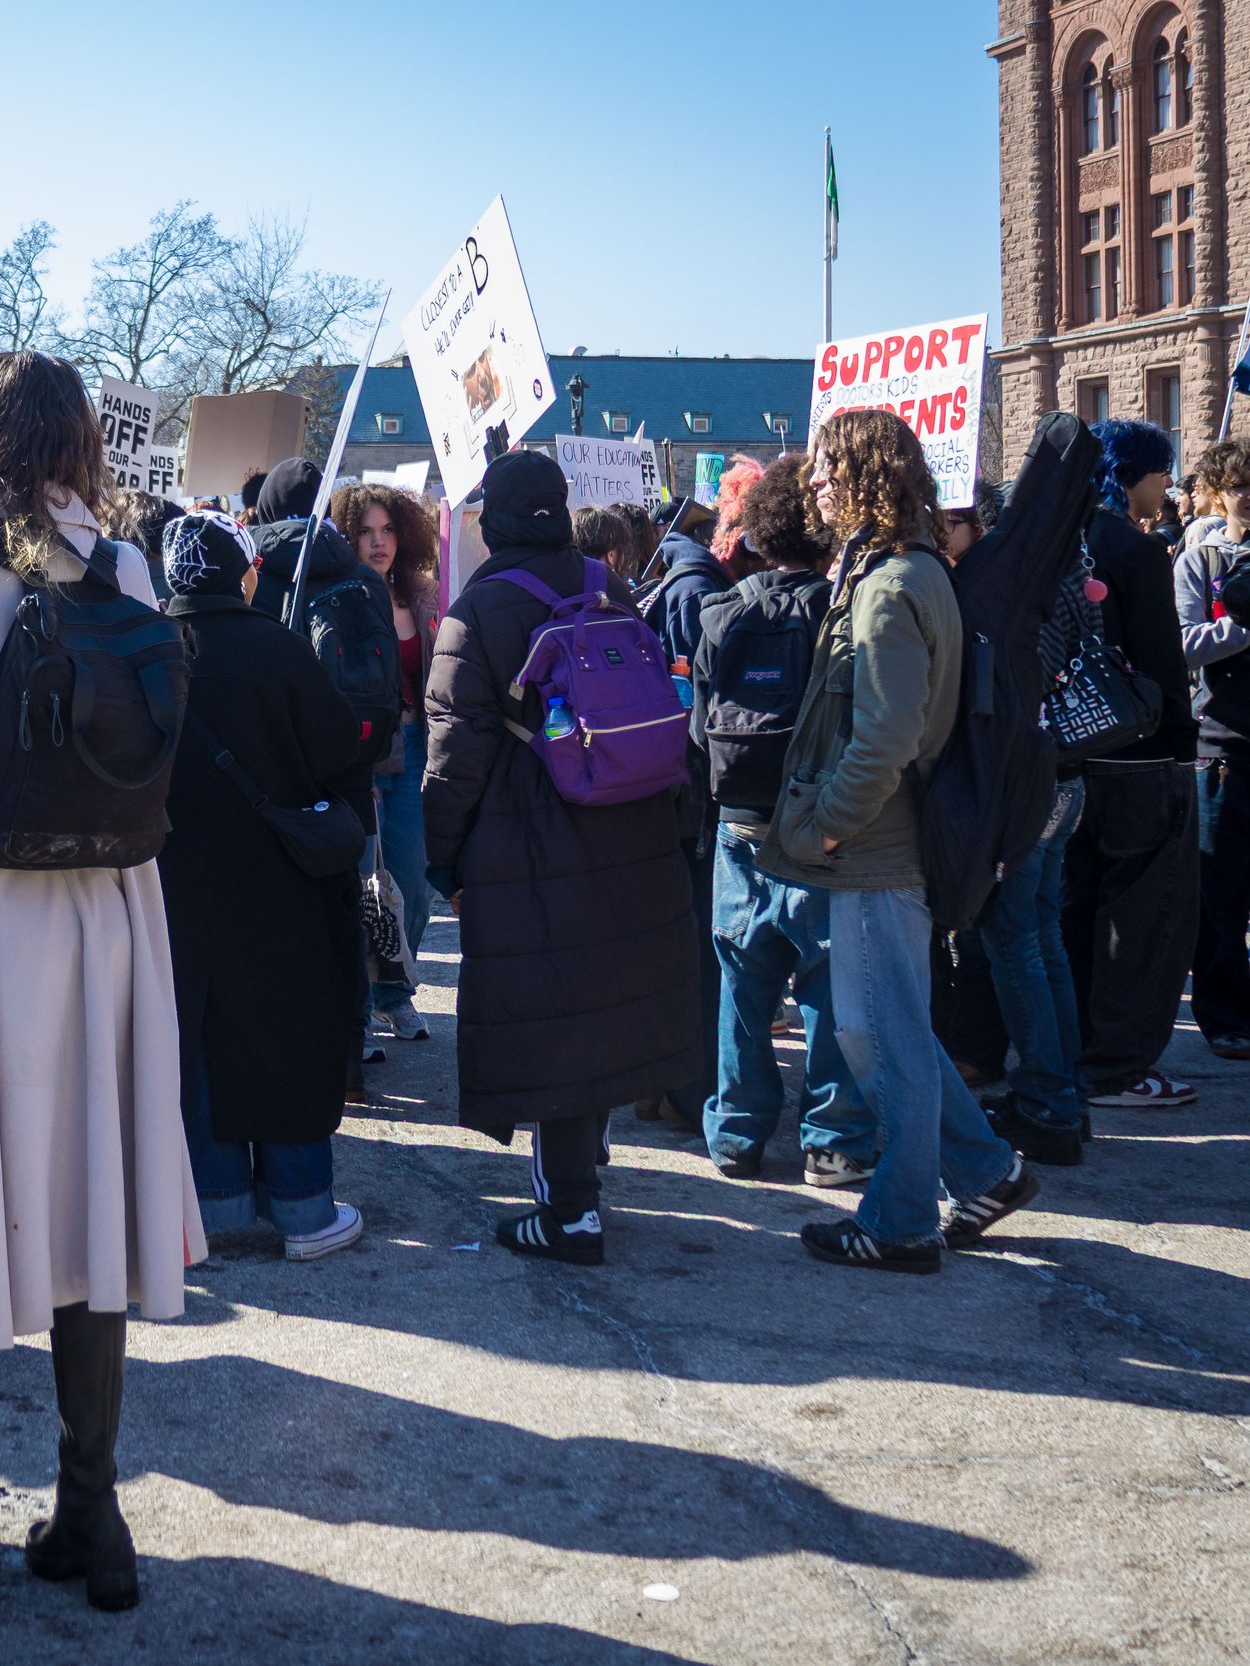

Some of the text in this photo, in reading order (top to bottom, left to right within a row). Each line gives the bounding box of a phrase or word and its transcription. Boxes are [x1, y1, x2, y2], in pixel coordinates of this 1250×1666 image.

[465, 236, 489, 296] B
[818, 324, 982, 392] SUPPORT
[887, 374, 919, 398] KIDS
[102, 393, 151, 425] HANDS
[100, 412, 148, 455] OFF
[108, 450, 129, 467] OUR
[562, 441, 591, 464] OUR
[930, 455, 969, 475] RKERS
[149, 455, 174, 479] NDS
[641, 464, 656, 485] FF
[146, 469, 174, 494] FF
[571, 471, 634, 500] MATTERS
[937, 476, 971, 501] ILY
